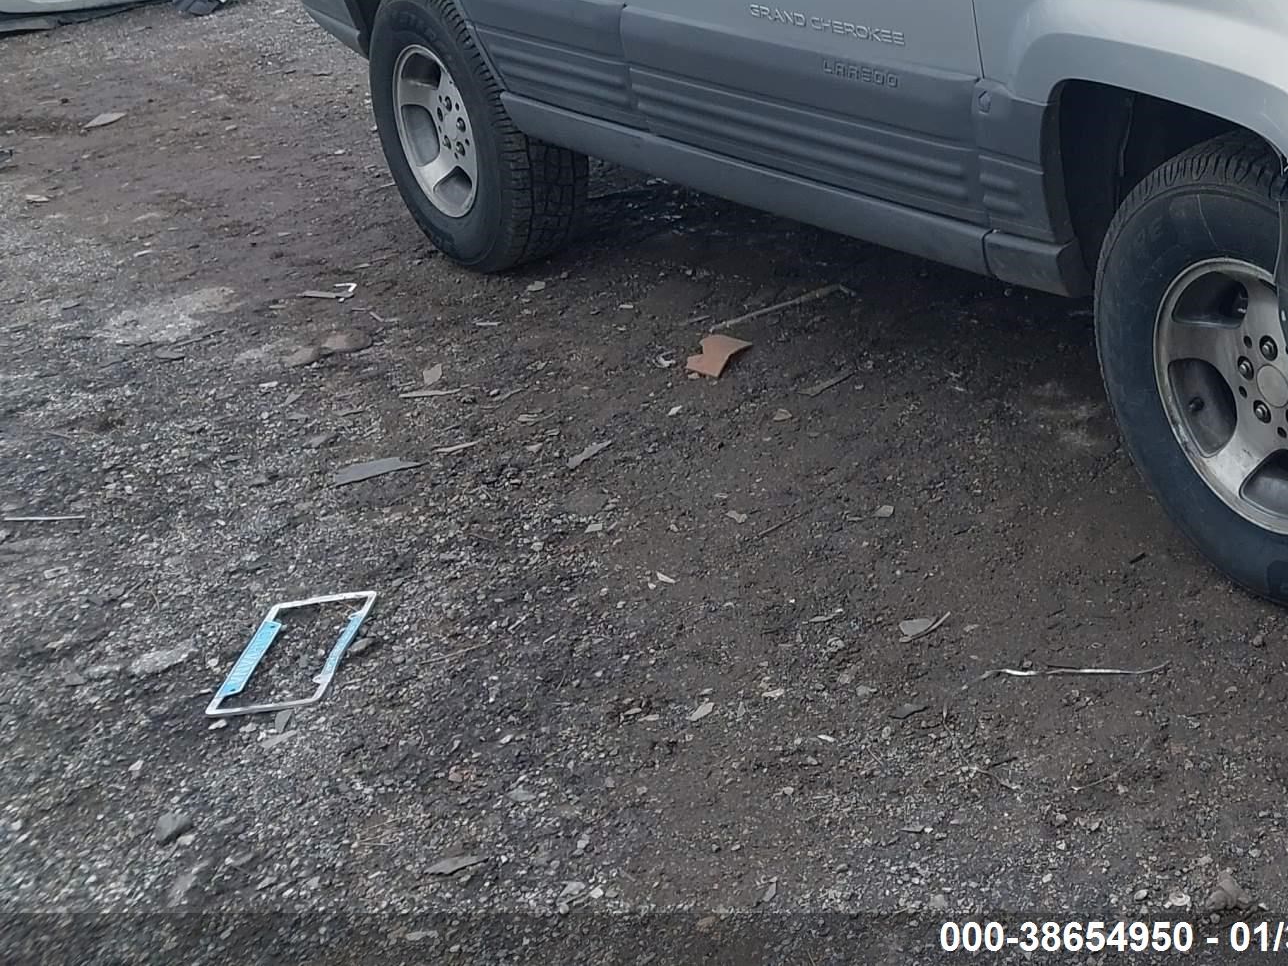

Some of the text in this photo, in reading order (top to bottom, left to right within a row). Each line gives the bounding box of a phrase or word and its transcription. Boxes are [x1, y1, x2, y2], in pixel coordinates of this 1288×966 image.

[748, 3, 906, 46] GRAND CHEROKEE
[822, 58, 900, 88] LAREDO
